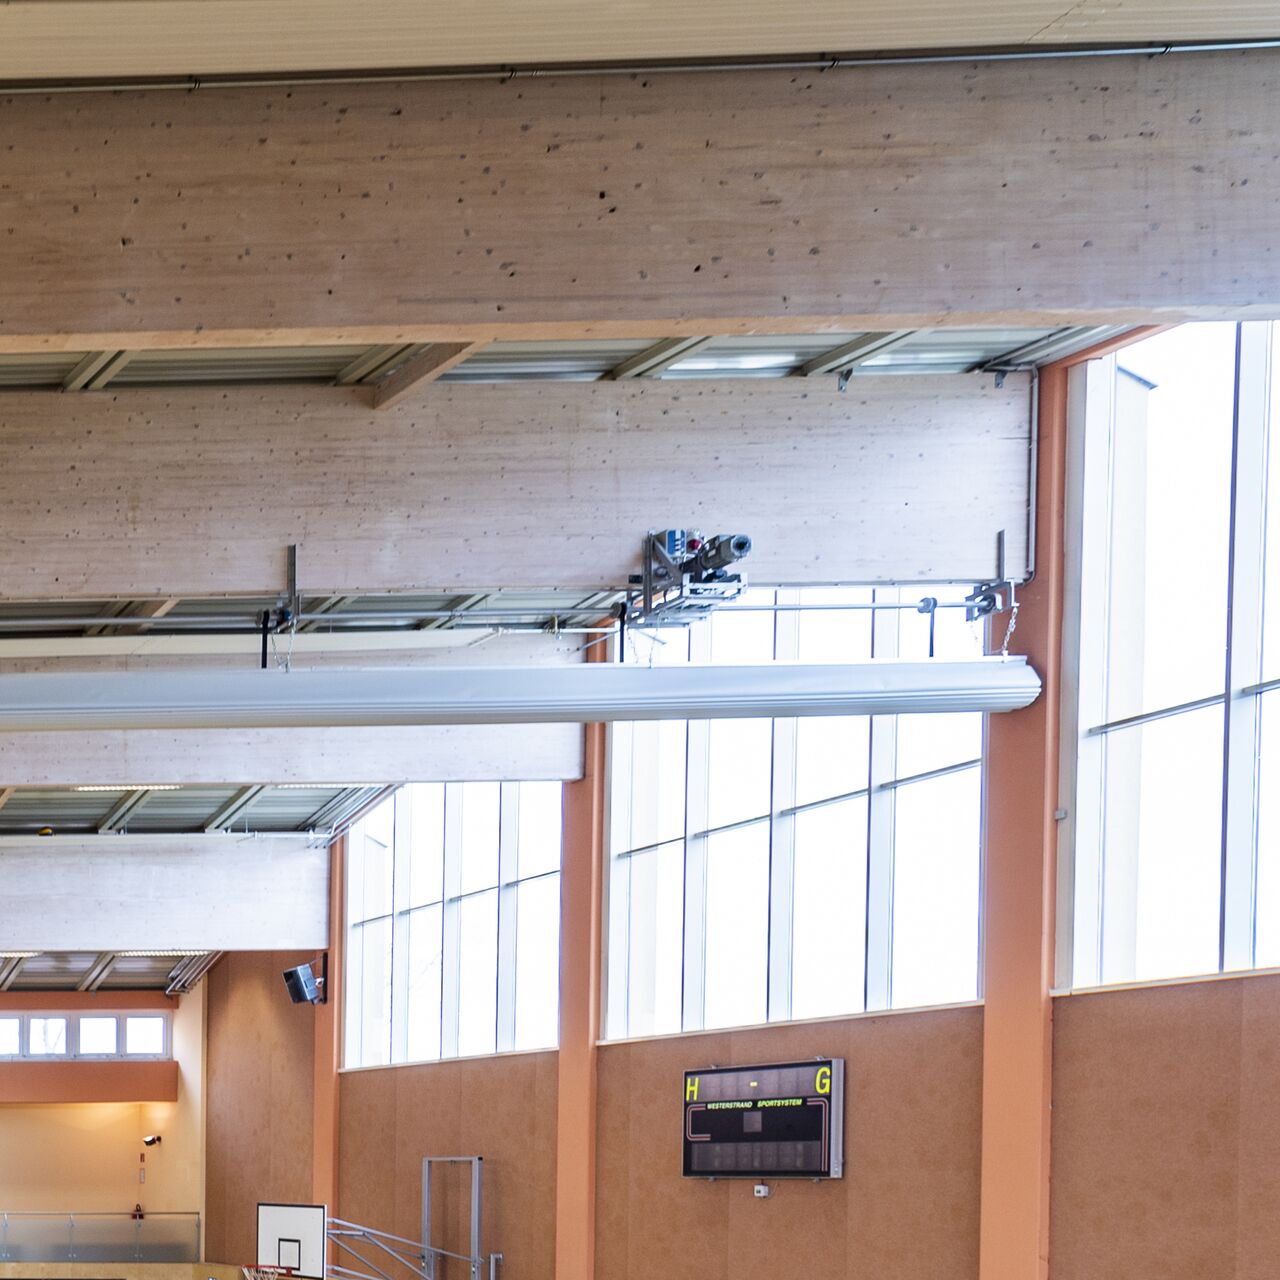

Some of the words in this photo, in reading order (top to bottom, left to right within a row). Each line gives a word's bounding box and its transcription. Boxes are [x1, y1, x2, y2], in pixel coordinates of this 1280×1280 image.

[686, 1077, 699, 1101] H
[815, 1067, 831, 1094] G
[757, 1098, 803, 1108] SPORTSYSTEM
